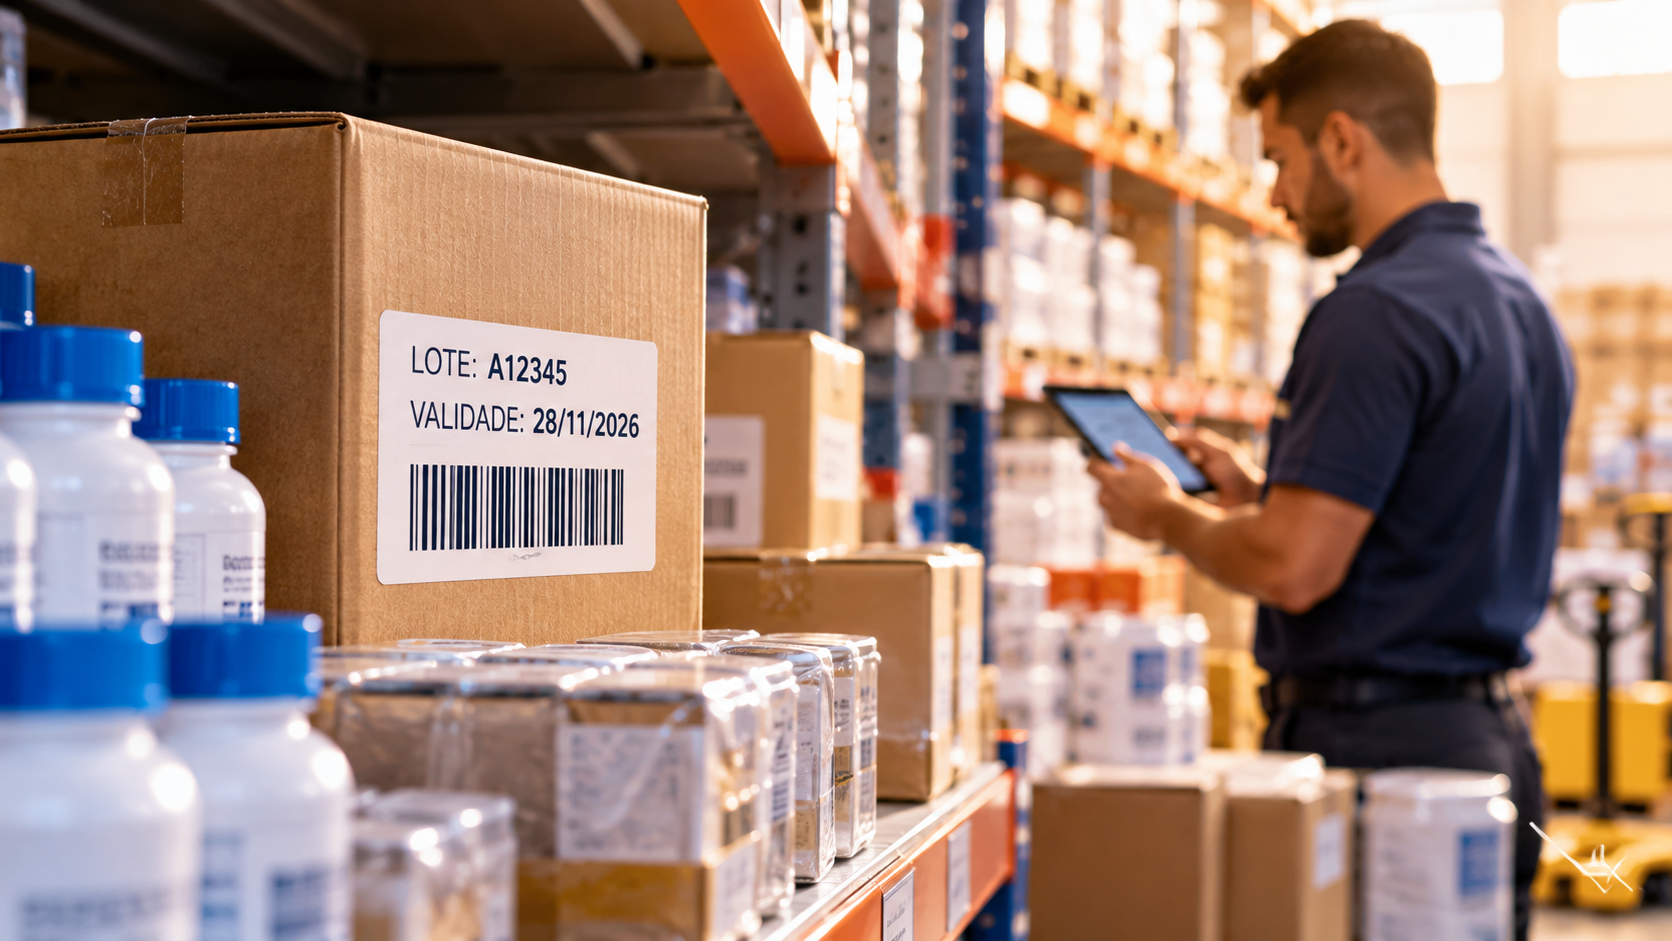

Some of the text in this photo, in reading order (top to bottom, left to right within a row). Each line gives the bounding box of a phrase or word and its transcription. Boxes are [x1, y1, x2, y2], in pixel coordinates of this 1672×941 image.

[412, 345, 568, 386] LOTE: A12345
[410, 400, 640, 438] VALIDADE: 28/11/2026
